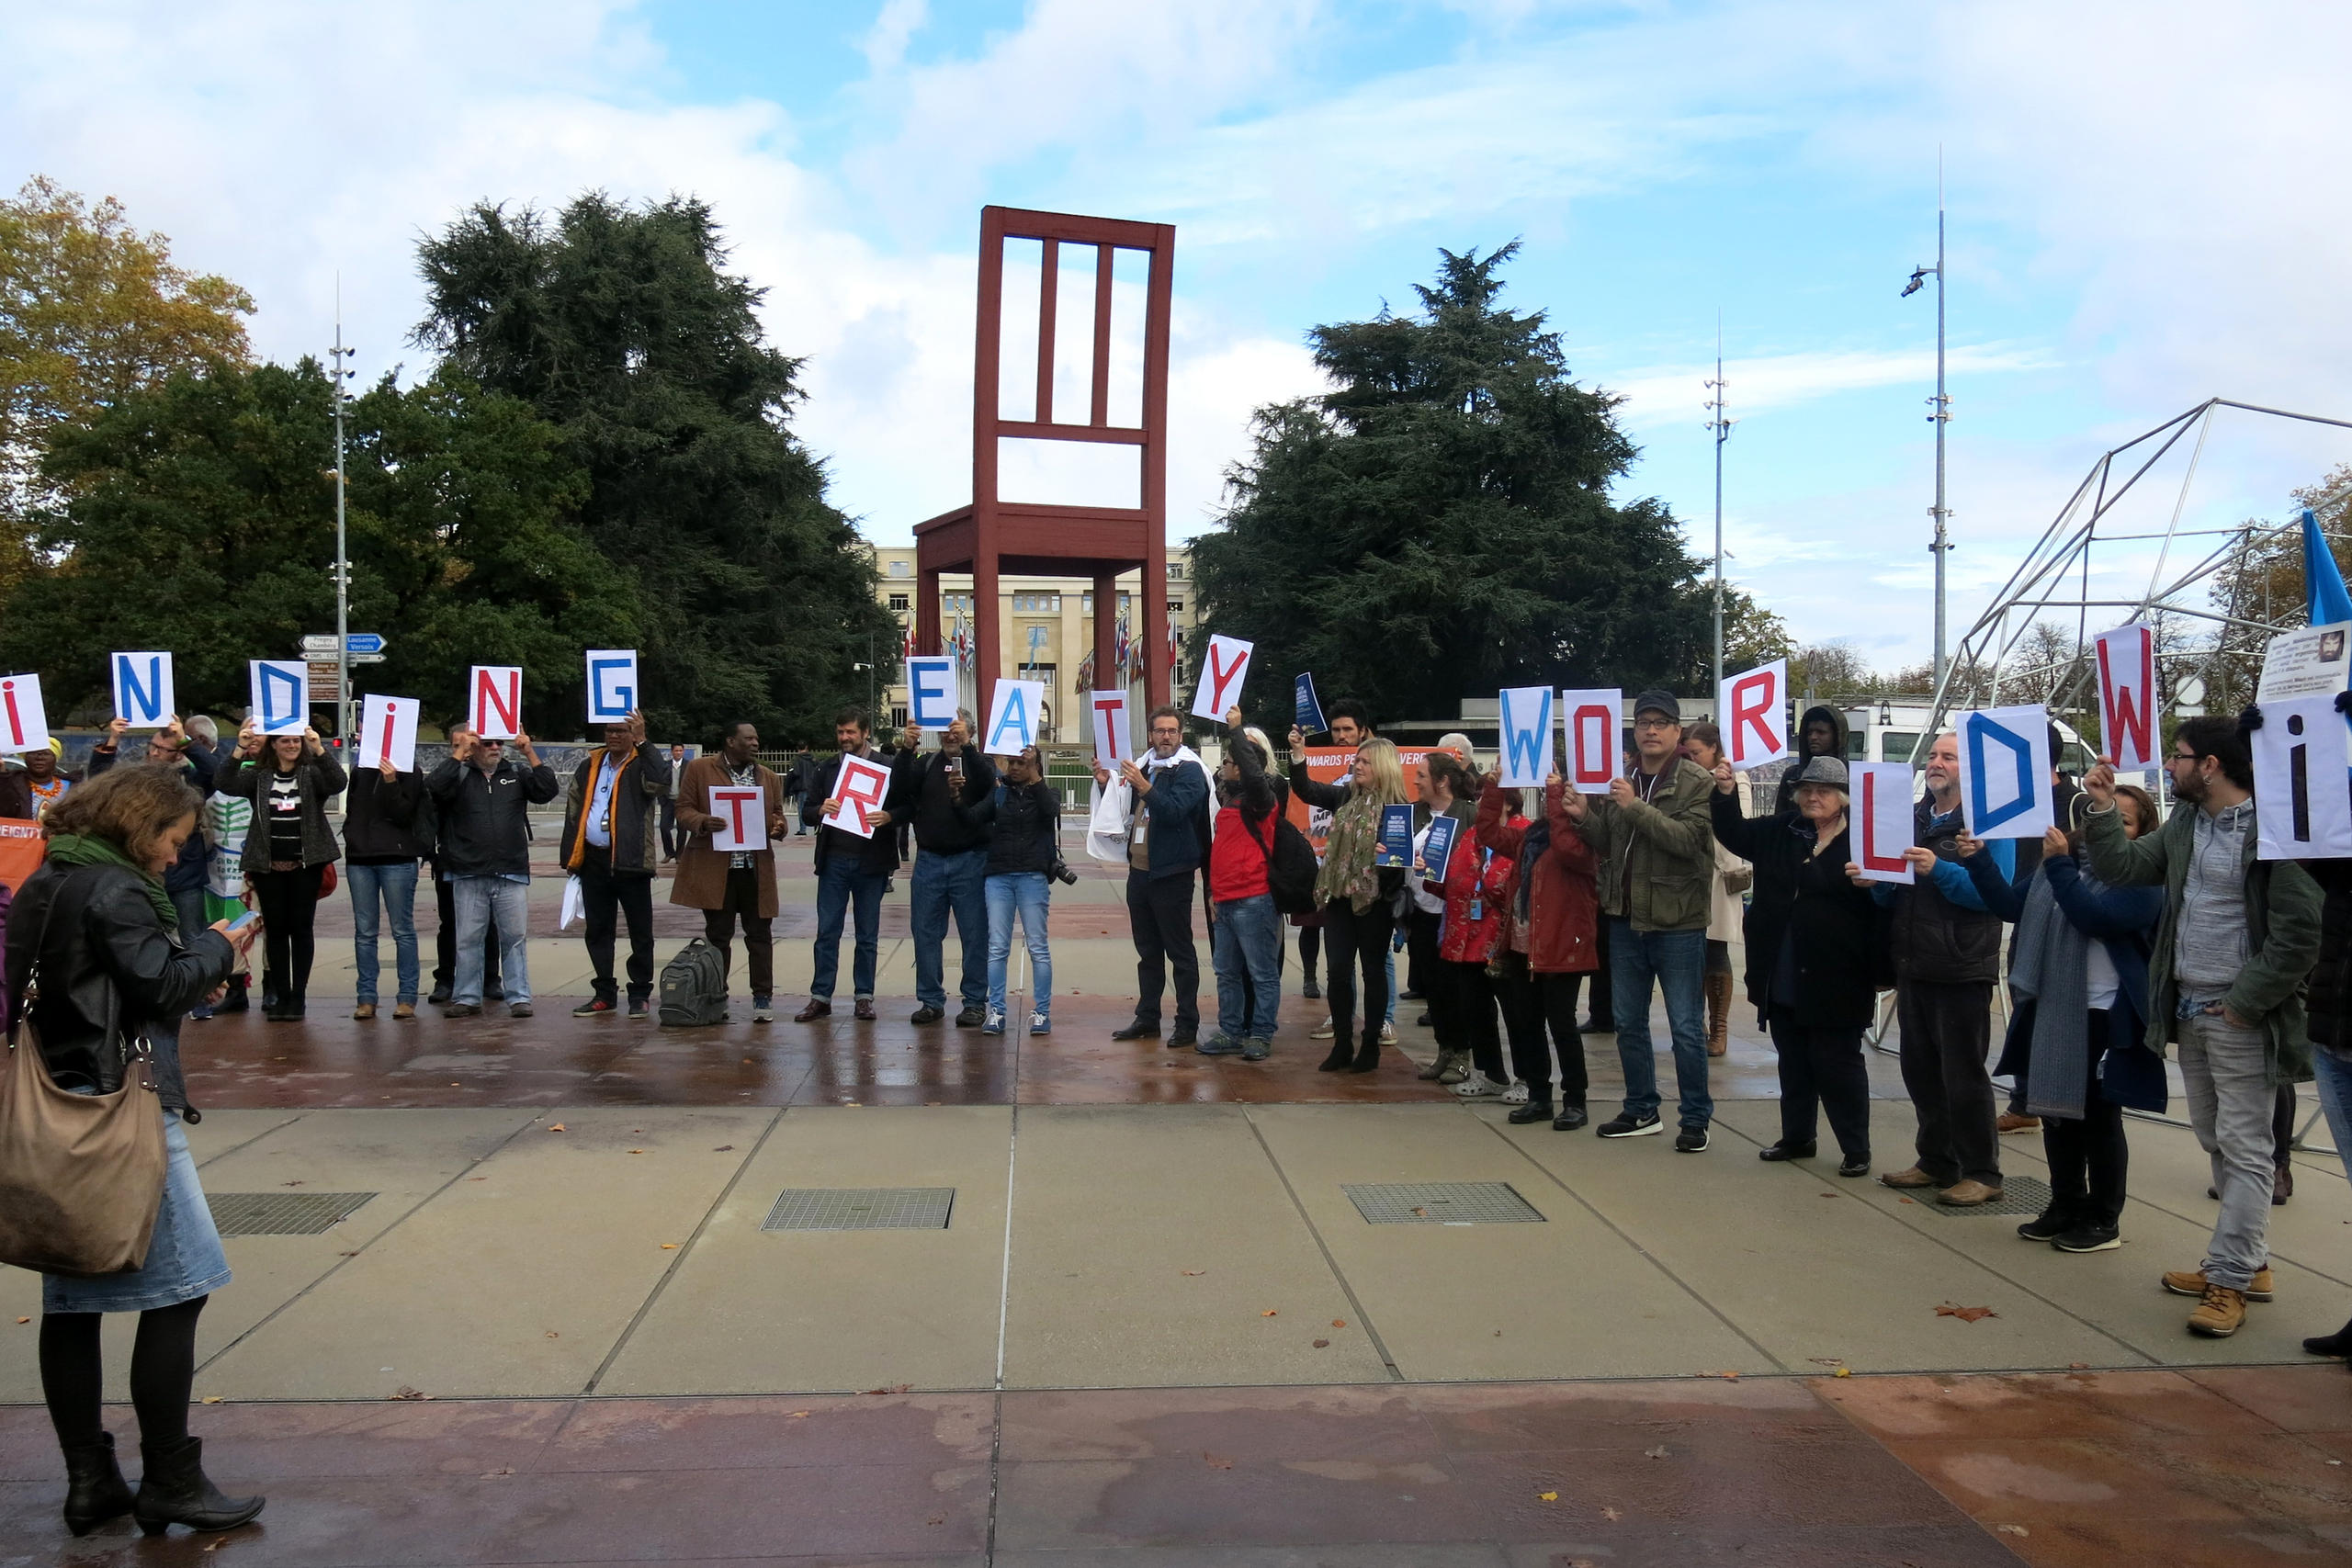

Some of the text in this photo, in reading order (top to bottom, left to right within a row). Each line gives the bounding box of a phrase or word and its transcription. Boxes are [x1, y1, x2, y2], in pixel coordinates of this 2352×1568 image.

[347, 635, 378, 643] Lausanne
[119, 655, 162, 722] N
[259, 662, 301, 733] D
[477, 671, 518, 736] N
[593, 659, 633, 716] G
[910, 661, 953, 727] E
[1210, 643, 1248, 714] Y
[2098, 628, 2152, 768] W
[991, 688, 1030, 747] A
[1095, 699, 1123, 761] T
[1500, 690, 1552, 781] W
[1732, 671, 1781, 761] R
[829, 761, 887, 833] R
[1967, 712, 2035, 837] D
[0, 825, 43, 839] EIGNTY
[715, 792, 757, 844] T
[1865, 773, 1907, 873] L
